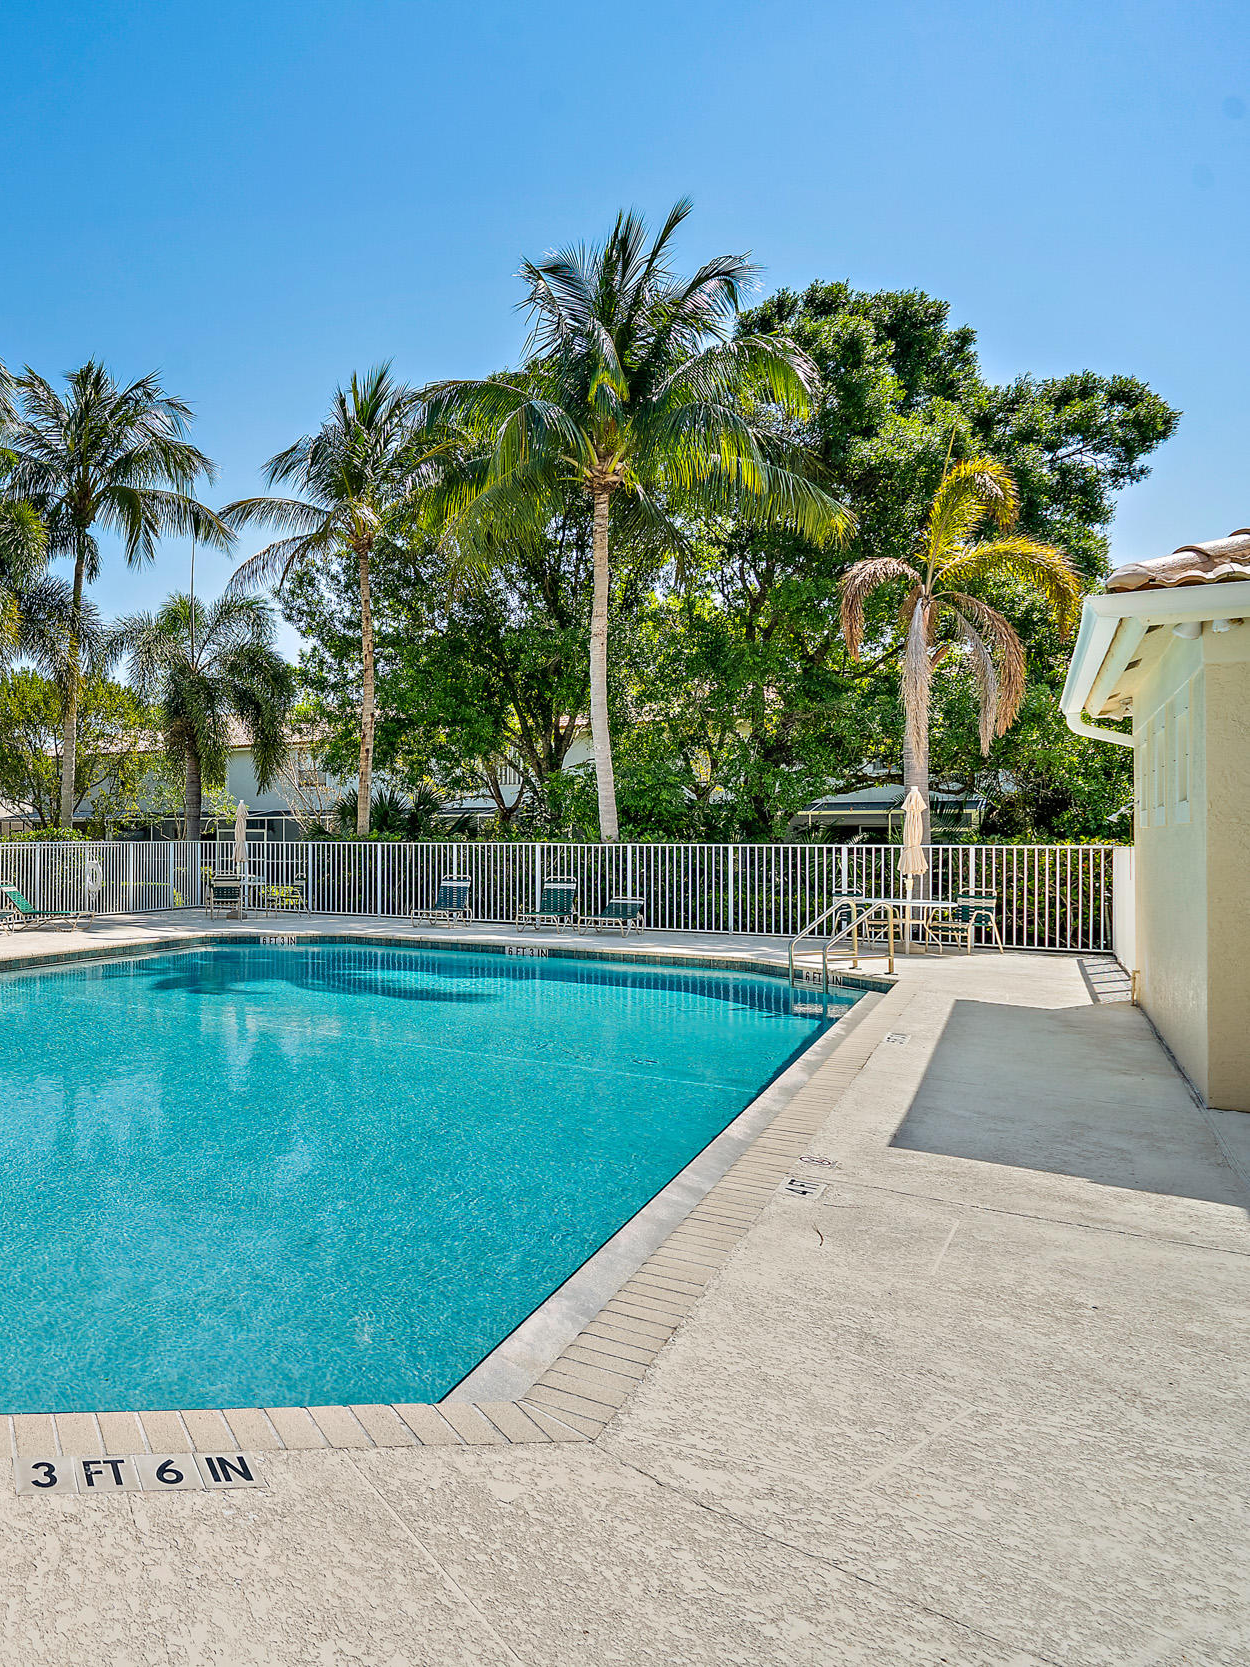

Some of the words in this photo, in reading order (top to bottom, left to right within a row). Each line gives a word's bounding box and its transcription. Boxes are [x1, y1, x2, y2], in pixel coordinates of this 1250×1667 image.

[262, 936, 267, 945] 6
[270, 936, 279, 945] FT
[280, 936, 285, 946] 3
[287, 936, 296, 946] IN
[508, 946, 513, 956] 6
[516, 946, 526, 957] FT
[529, 948, 534, 957] 3
[537, 948, 548, 958] IN
[812, 972, 822, 984] FT
[832, 975, 842, 986] IN
[788, 1179, 819, 1190] FT
[31, 1461, 58, 1488] 3
[82, 1459, 124, 1487] FT
[155, 1458, 184, 1485] 6
[205, 1455, 255, 1483] IN
